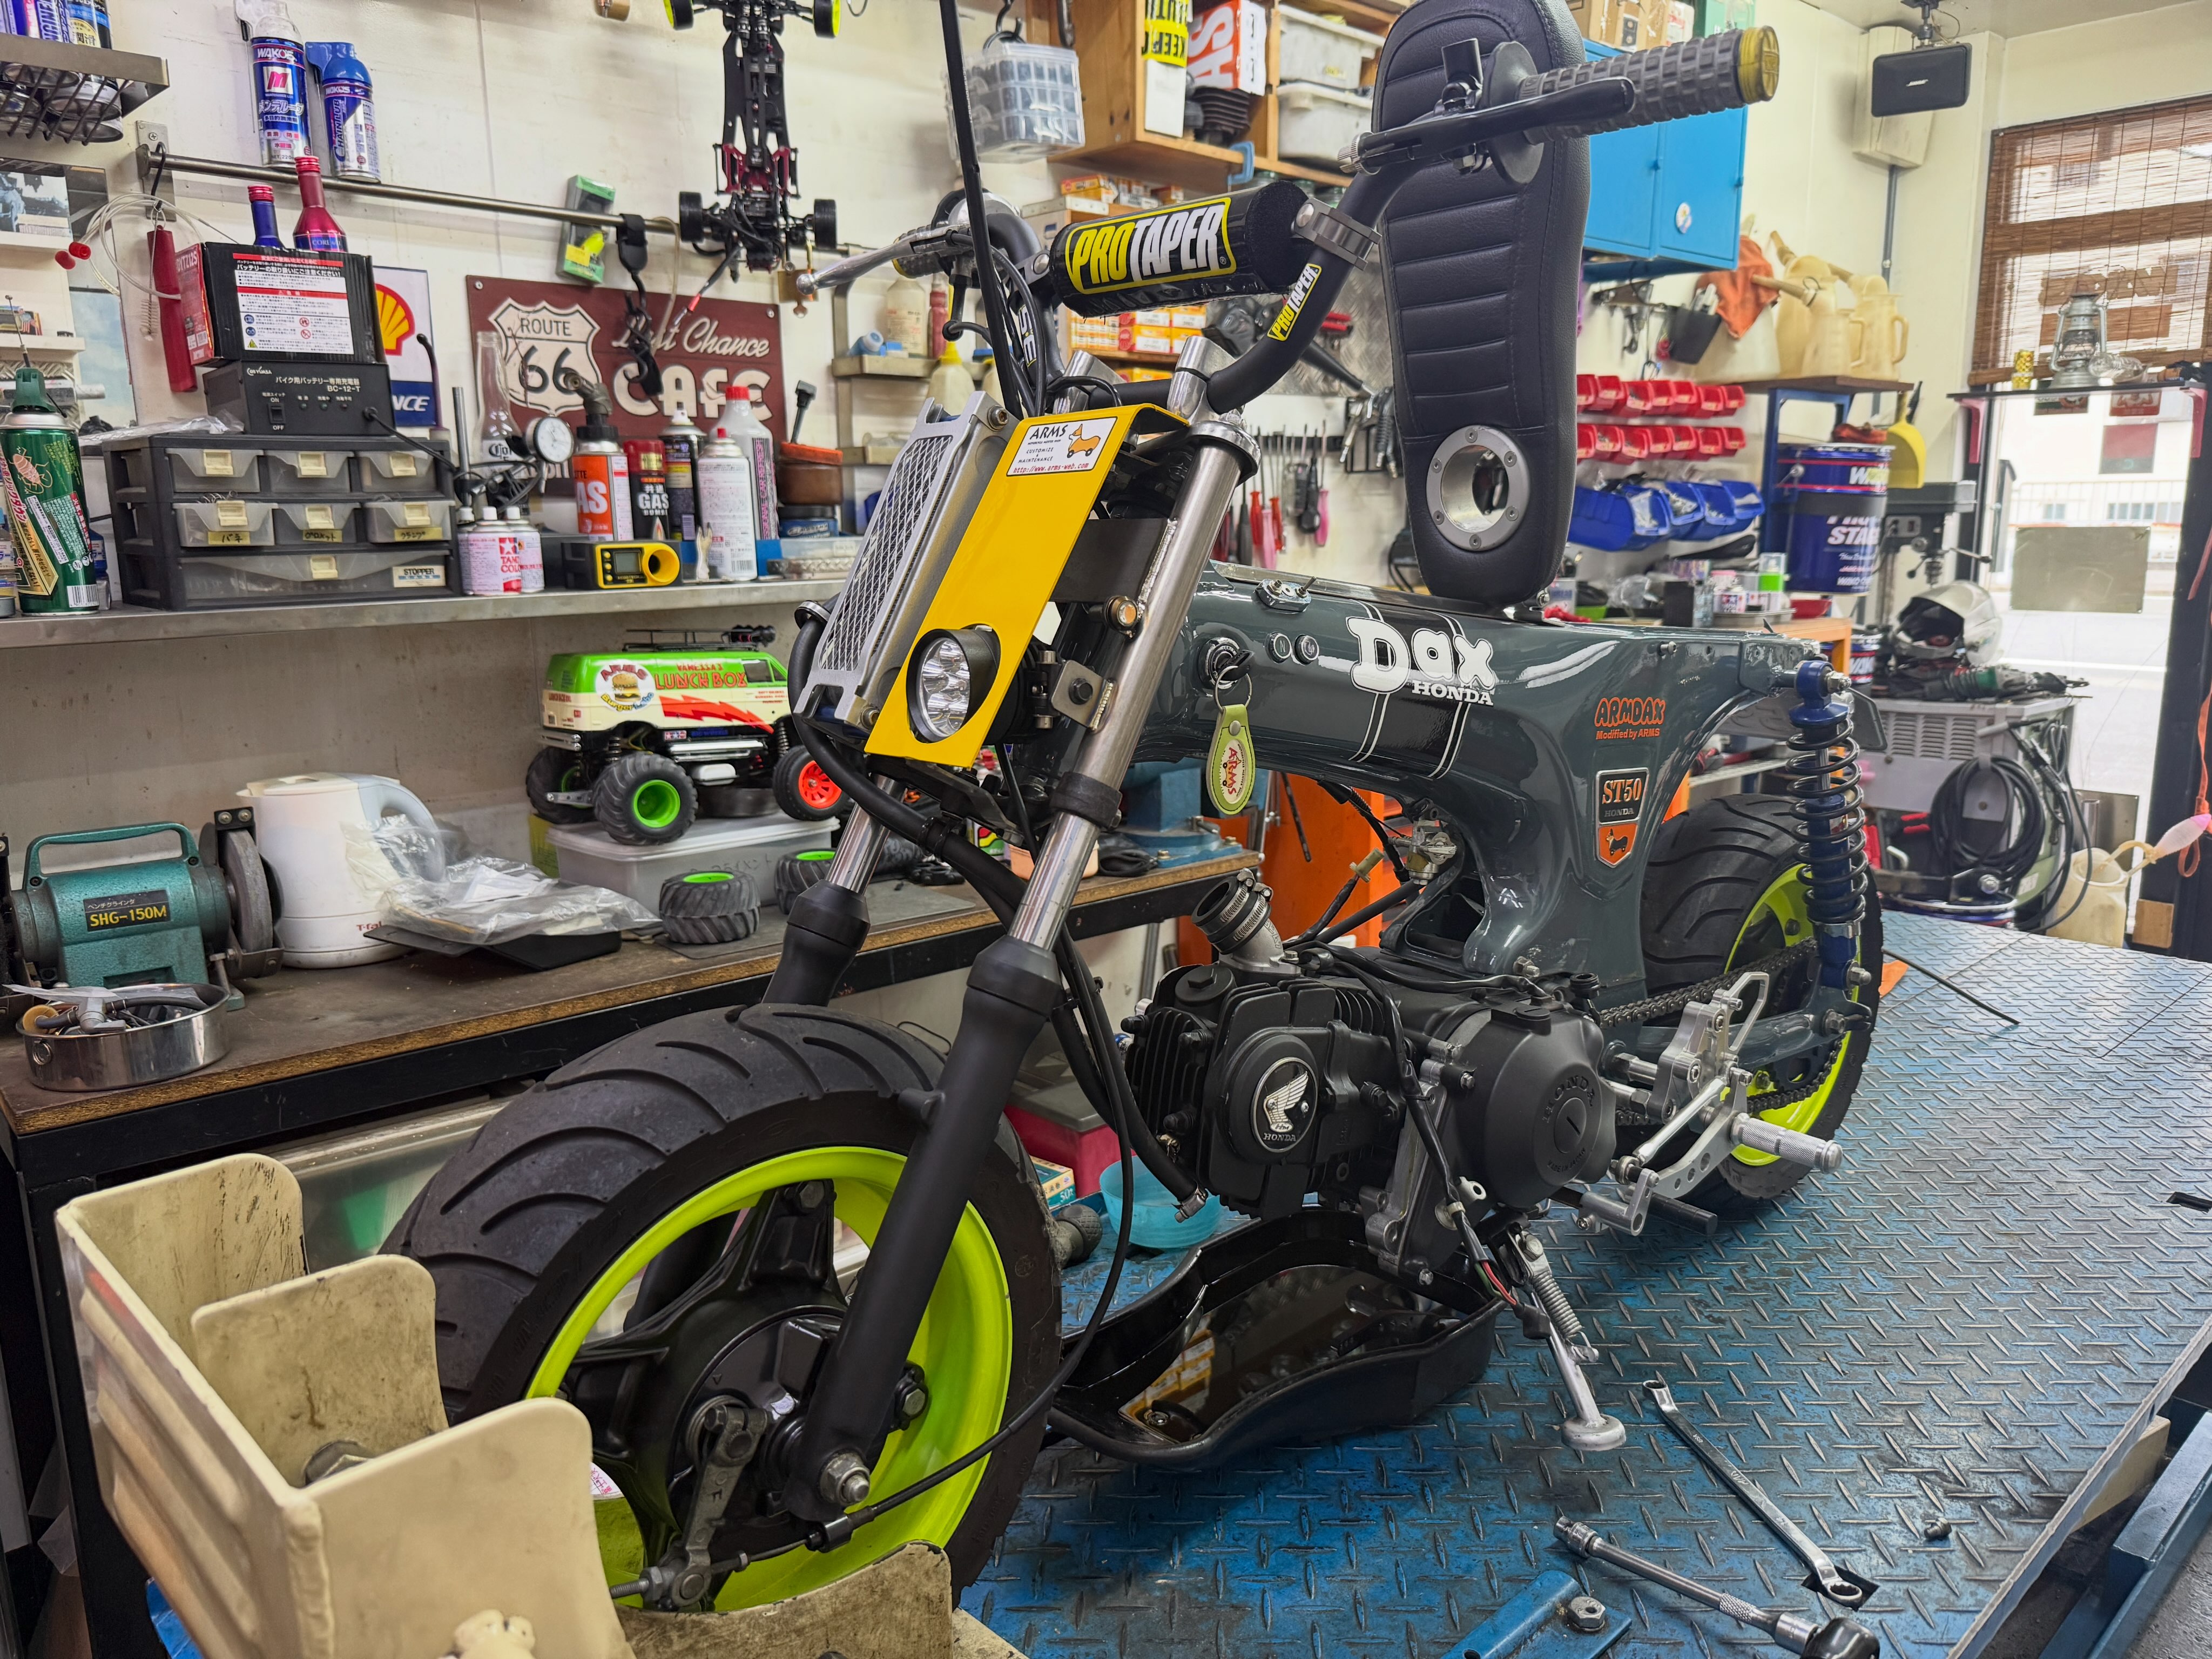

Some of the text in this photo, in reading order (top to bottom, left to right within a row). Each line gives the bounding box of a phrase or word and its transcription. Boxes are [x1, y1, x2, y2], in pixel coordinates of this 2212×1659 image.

[1069, 204, 1226, 285] PROTAPER
[1270, 264, 1318, 341] PROTAPER
[520, 318, 572, 336] ROUTE
[683, 316, 770, 358] Chance
[518, 345, 574, 395] 66
[275, 377, 360, 386] バイク用バッテリー専用充電器
[1030, 424, 1068, 440] ARMS
[1013, 463, 1089, 474] http://www.arms-web.com
[638, 493, 669, 509] GAS
[221, 535, 244, 543] バネ
[1346, 617, 1497, 695] Dax
[655, 672, 748, 690] LUNCH BOX
[601, 693, 634, 711] Burger
[1411, 679, 1494, 706] HONDA
[1594, 697, 1666, 727] ARMDAX
[1596, 728, 1660, 740] Modified by ARMS
[1228, 747, 1238, 795] ARMS
[1602, 778, 1643, 804] ST50
[1604, 807, 1635, 817] HONDA
[90, 905, 167, 927] SHG-150M
[1542, 1075, 1596, 1124] HONDA
[1263, 1133, 1297, 1142] HONDA
